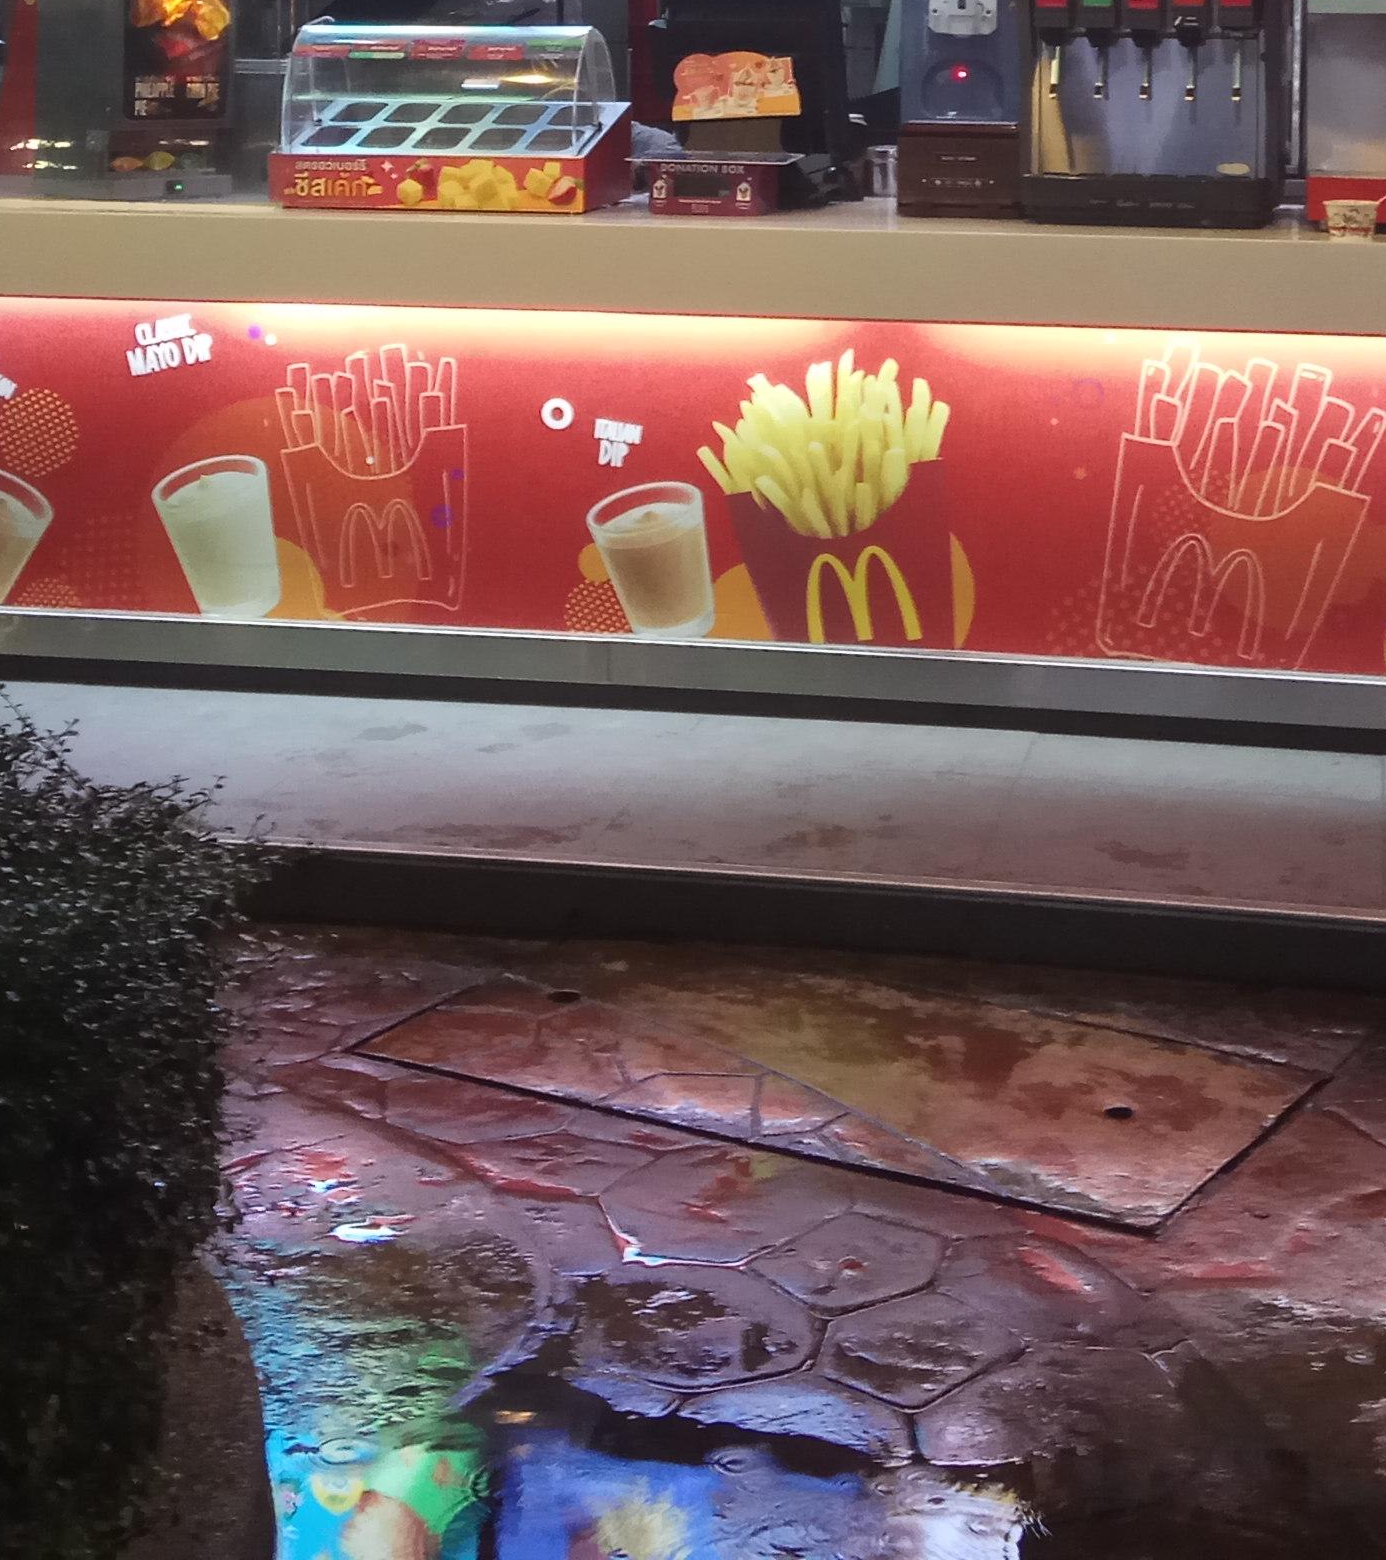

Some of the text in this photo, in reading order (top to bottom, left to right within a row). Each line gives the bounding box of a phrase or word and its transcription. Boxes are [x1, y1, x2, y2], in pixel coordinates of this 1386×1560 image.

[660, 163, 745, 174] DONATION BOX
[125, 333, 213, 376] MAYO DIP
[598, 439, 630, 467] DIP
